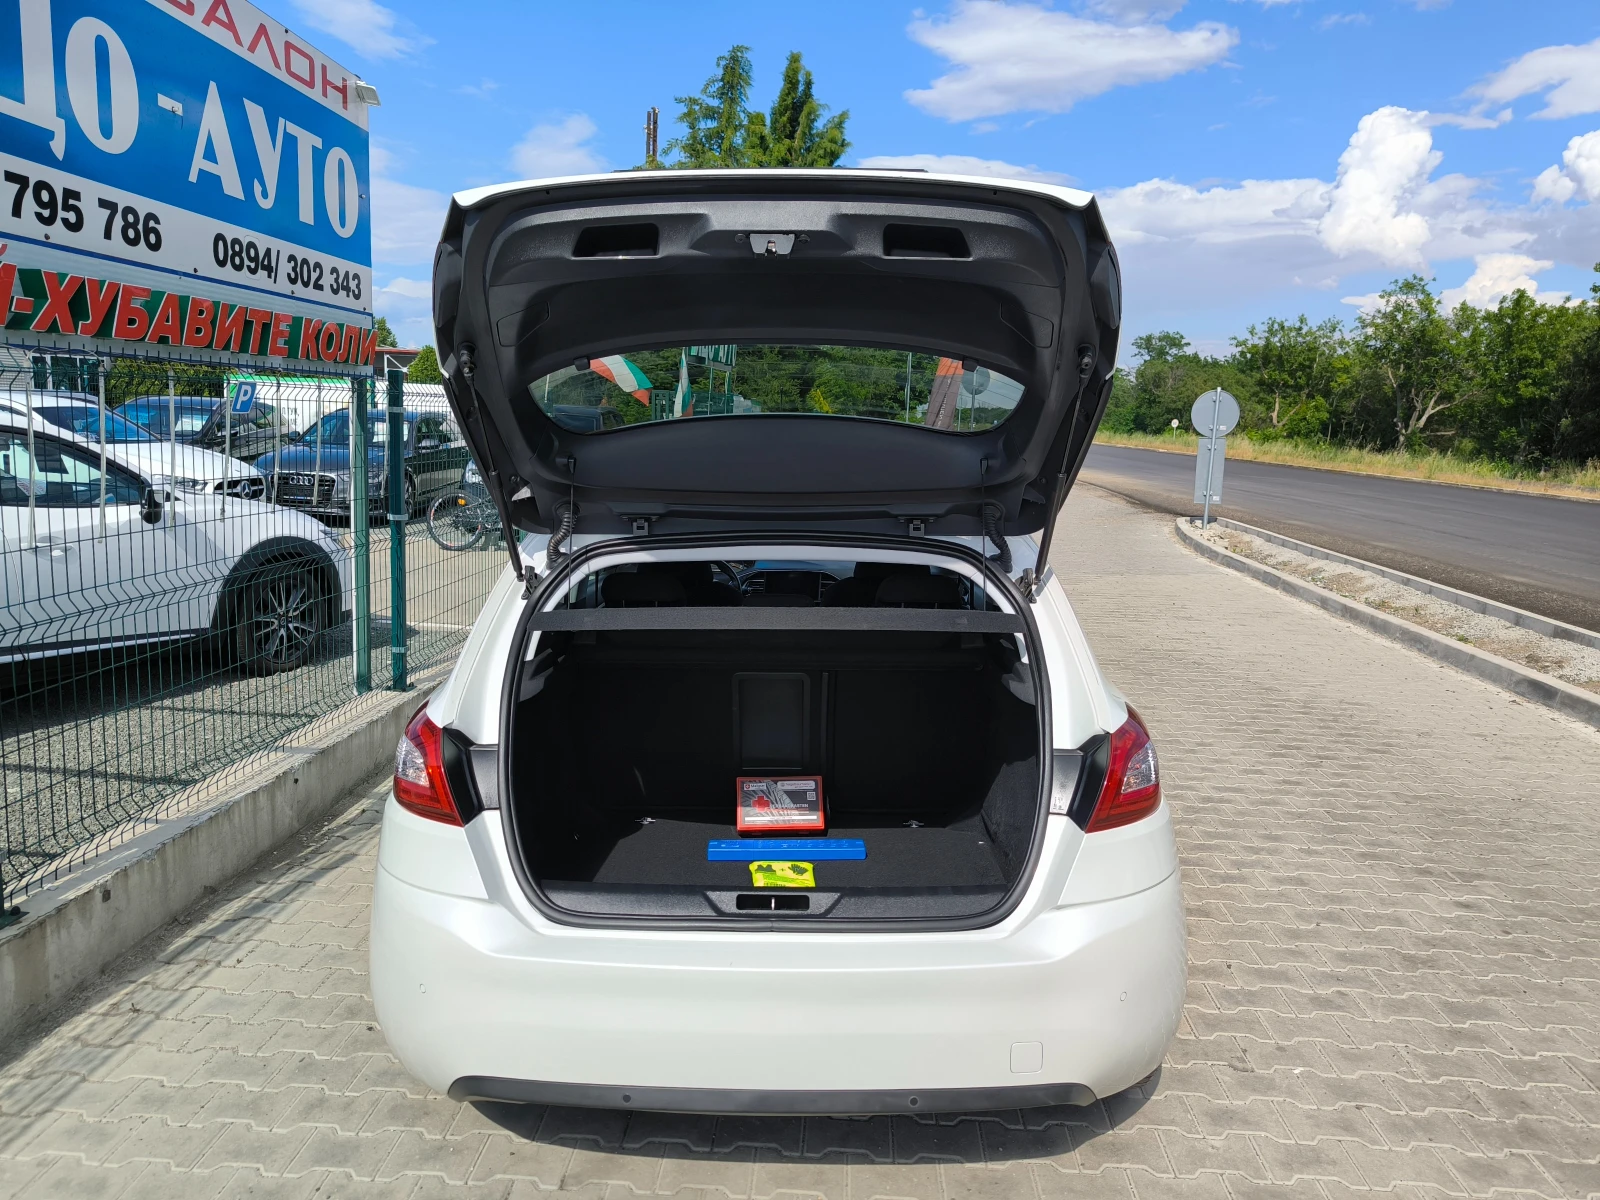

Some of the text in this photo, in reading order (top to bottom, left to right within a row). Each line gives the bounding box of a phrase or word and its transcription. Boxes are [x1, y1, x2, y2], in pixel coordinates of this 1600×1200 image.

[188, 80, 359, 239] АУТО
[4, 169, 162, 252] 795 786
[213, 232, 362, 300] 0894/ 302 343
[299, 316, 378, 366] КОЛИ
[236, 385, 252, 410] P
